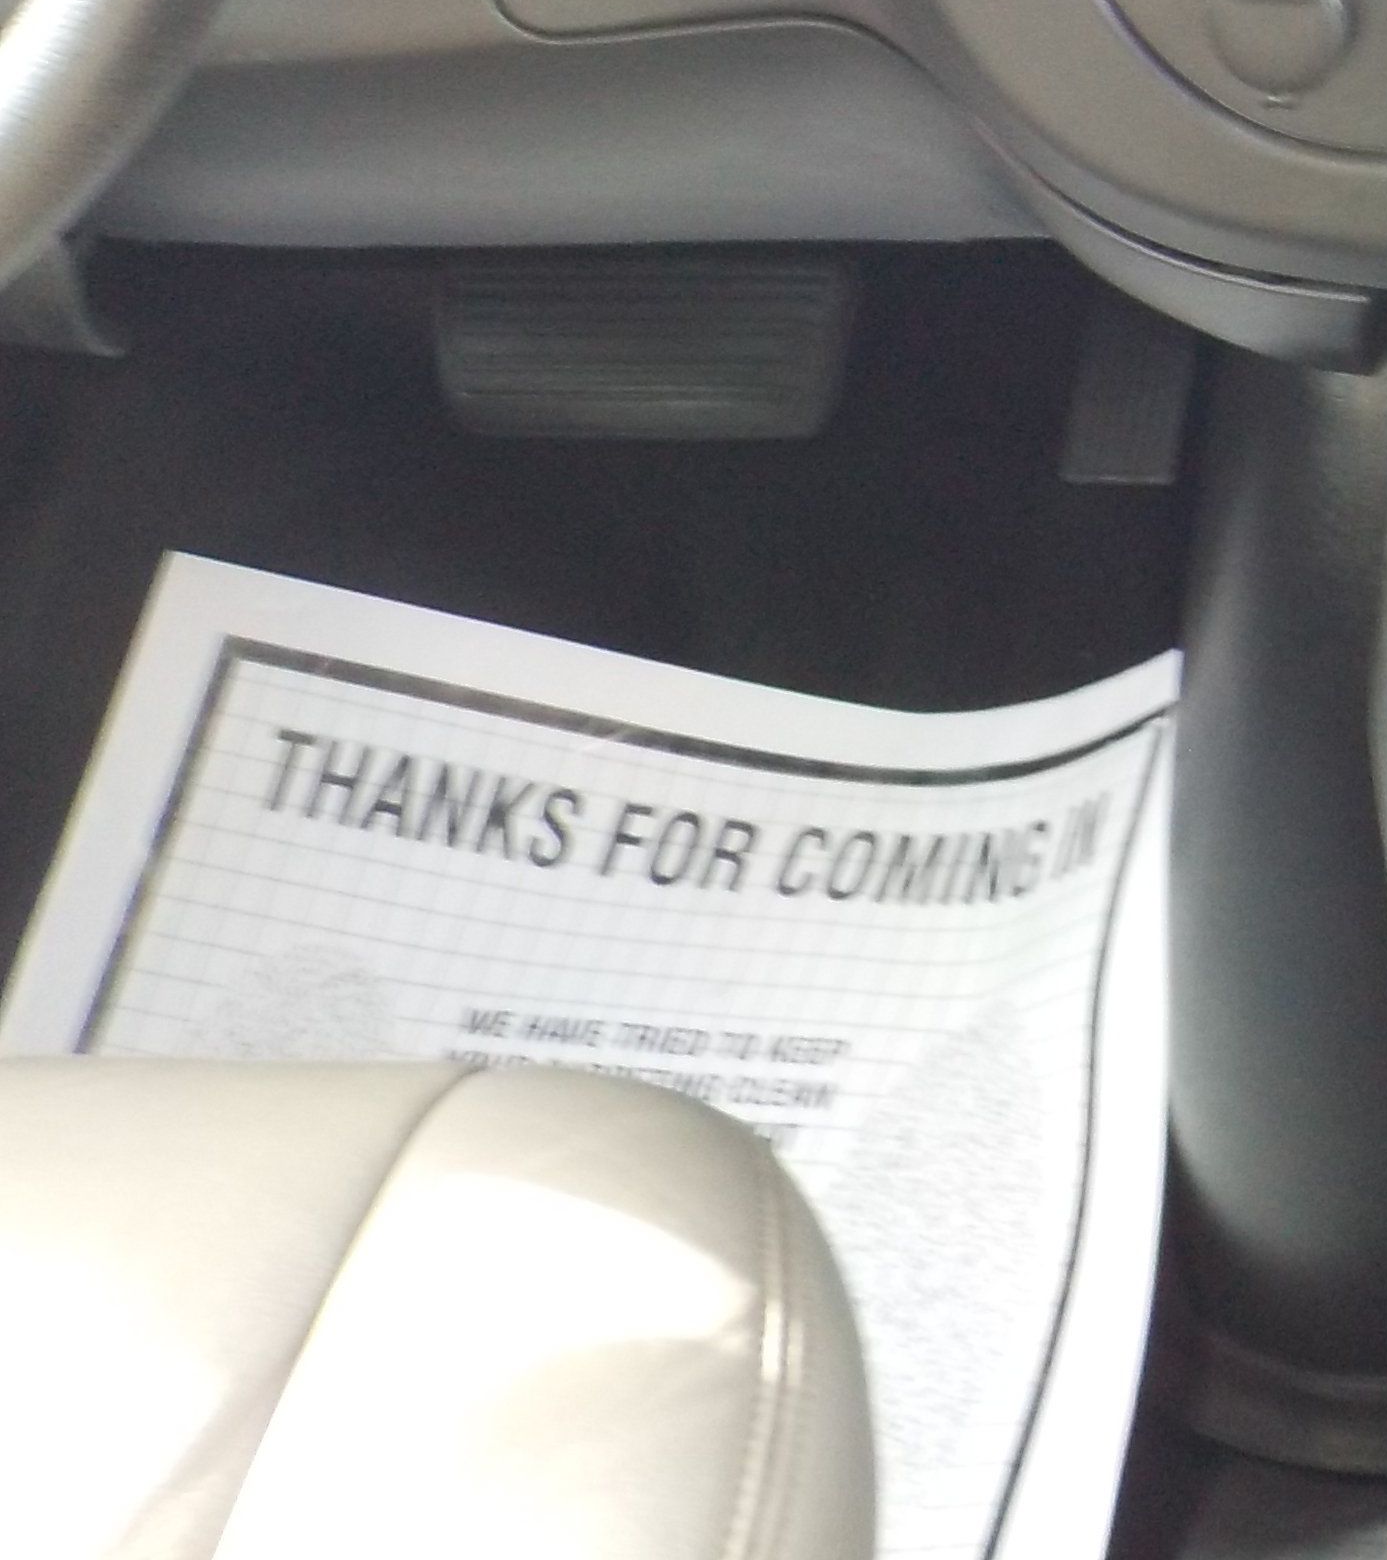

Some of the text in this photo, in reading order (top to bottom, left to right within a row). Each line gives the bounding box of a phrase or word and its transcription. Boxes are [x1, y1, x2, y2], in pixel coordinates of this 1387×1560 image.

[267, 728, 584, 868] THANKS
[596, 801, 759, 891] FOR
[775, 819, 1050, 905] COMING
[462, 1007, 517, 1039] WE
[524, 1013, 606, 1049] HAVE
[620, 1021, 712, 1056] TRIED
